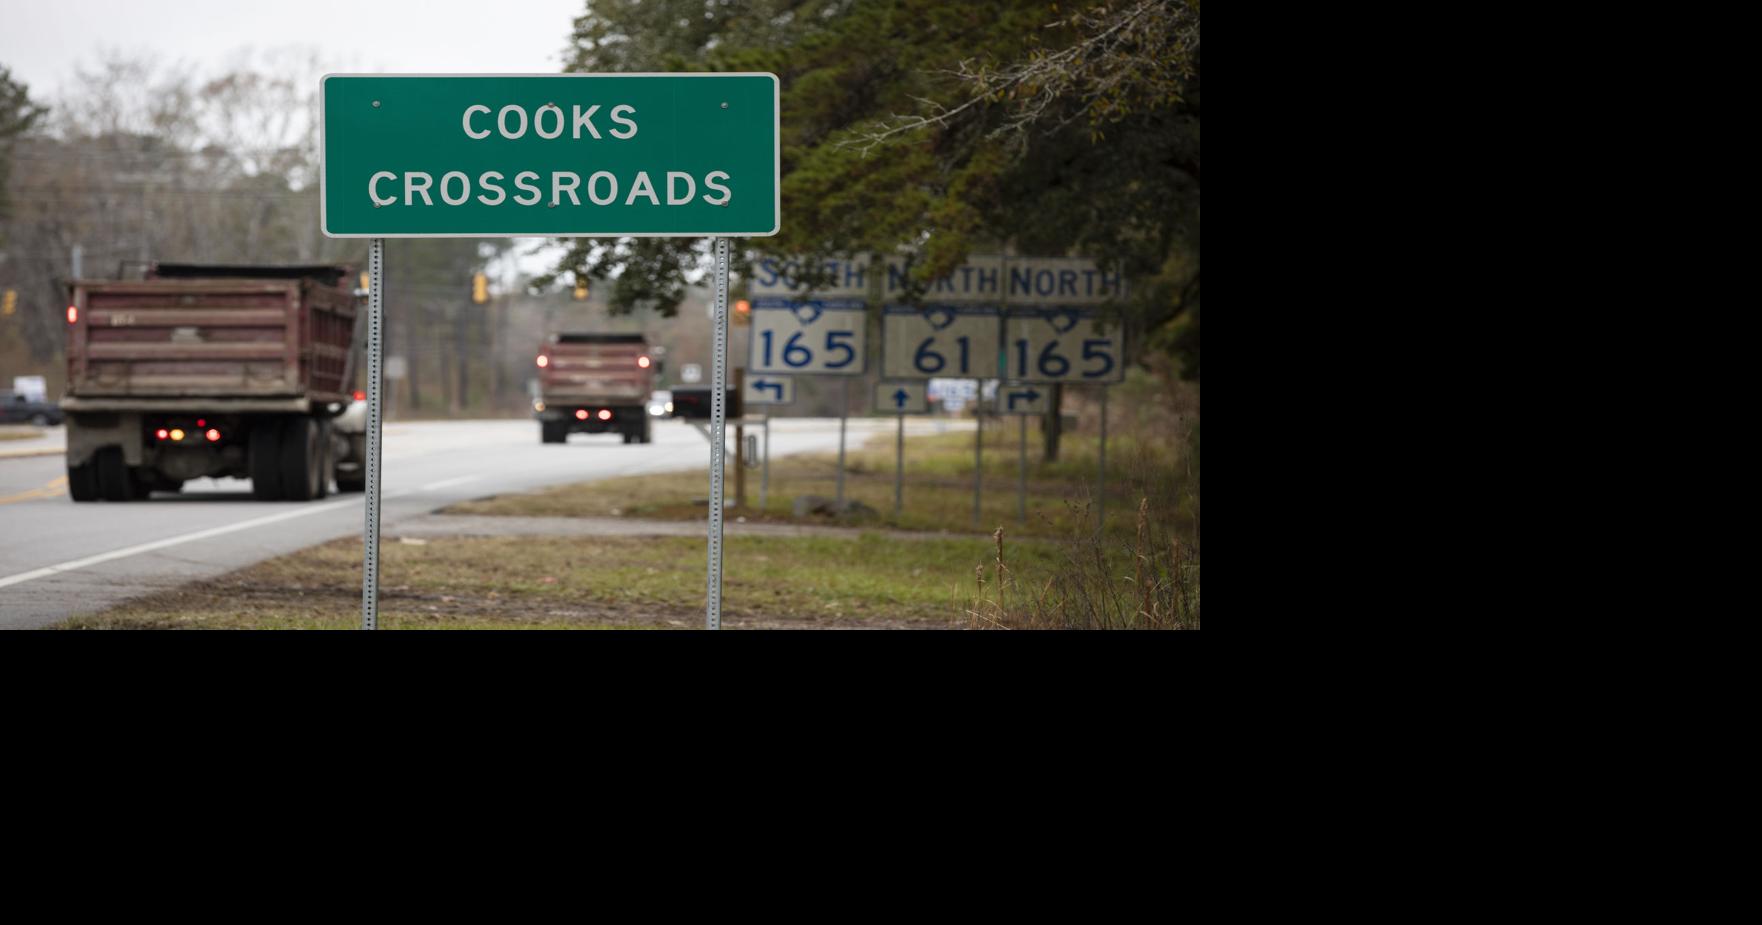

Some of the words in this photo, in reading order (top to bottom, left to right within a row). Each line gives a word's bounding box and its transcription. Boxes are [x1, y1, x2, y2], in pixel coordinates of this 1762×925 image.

[462, 105, 638, 139] COOKS
[368, 171, 733, 206] CROSSROADS
[759, 258, 865, 290] SOTH
[1010, 267, 1121, 296] NORTH
[760, 329, 856, 369] 165
[914, 336, 970, 375] 61
[1016, 339, 1115, 380] 165
